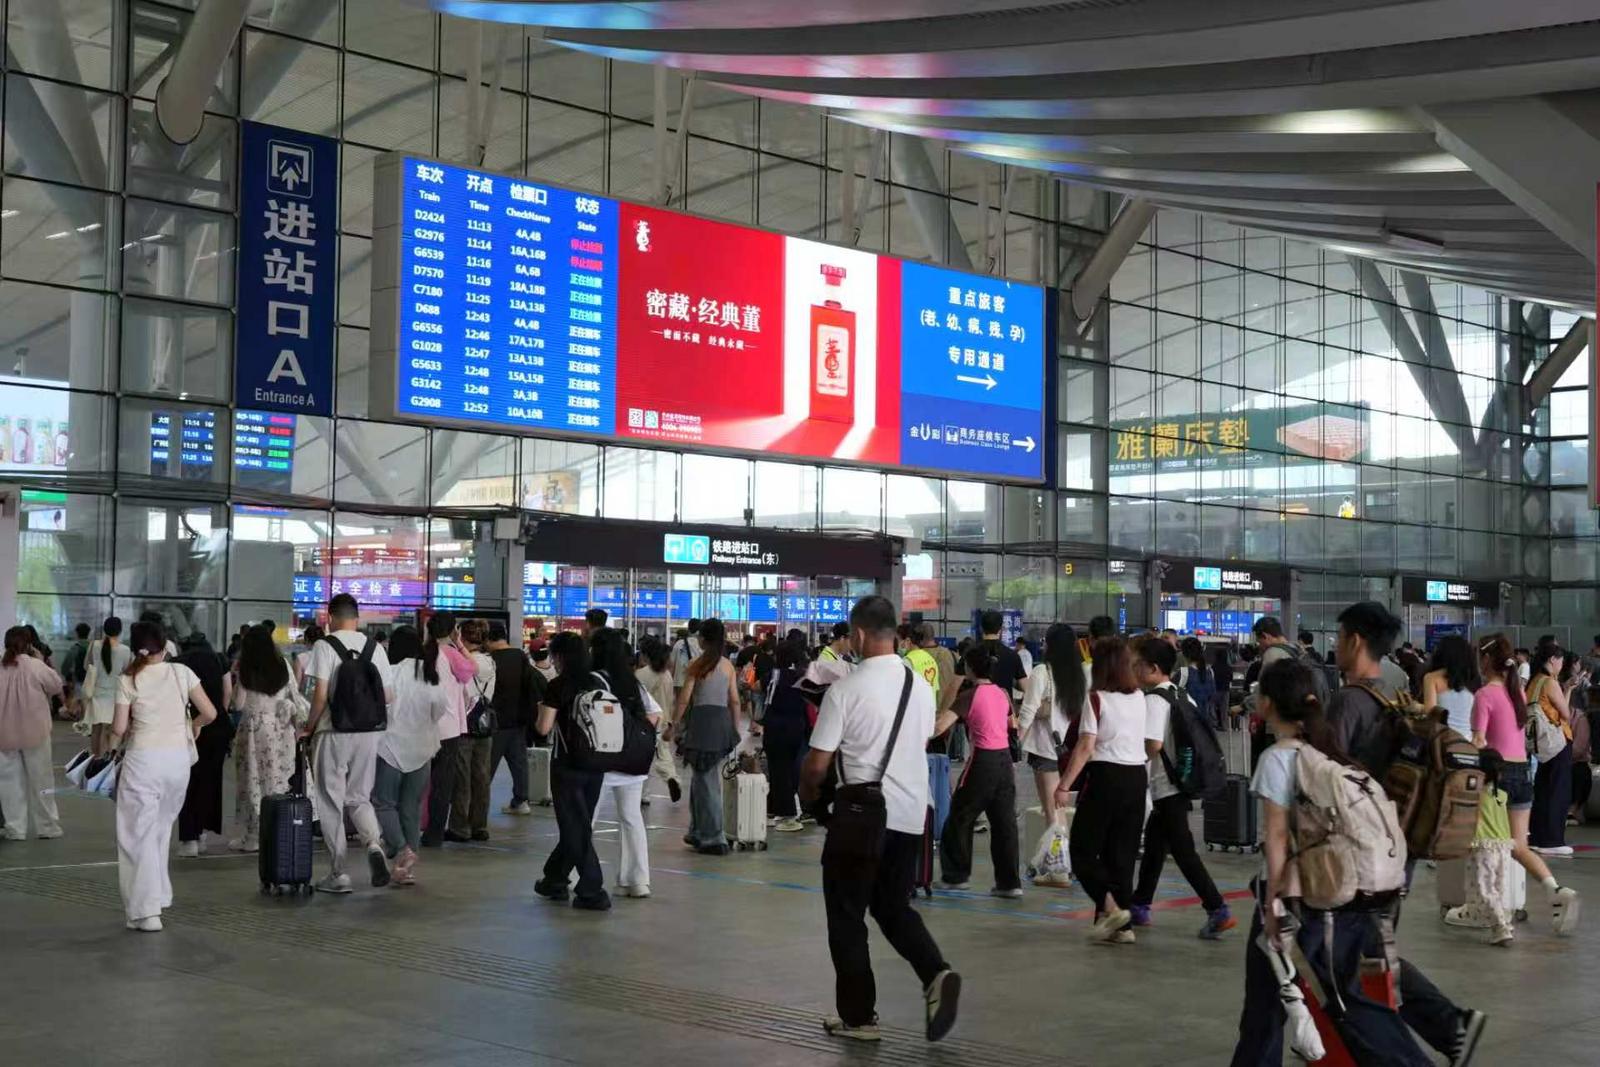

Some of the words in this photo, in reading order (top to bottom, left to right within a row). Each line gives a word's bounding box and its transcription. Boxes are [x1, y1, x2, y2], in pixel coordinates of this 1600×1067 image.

[416, 164, 444, 184] 车次
[467, 174, 493, 195] 开点
[575, 197, 600, 215] 状态
[419, 190, 440, 202] Train
[469, 200, 490, 212] Time
[415, 210, 444, 223] D2424
[468, 220, 491, 232] 11:13
[415, 229, 444, 241] G2976
[468, 238, 491, 250] 11:14
[414, 247, 444, 260] G6539
[467, 256, 491, 268] 11:16
[414, 265, 443, 278] D7570
[467, 275, 491, 286] 11:19
[467, 293, 490, 304] 11:25
[949, 286, 1005, 314] 重点旅客
[466, 311, 489, 322] 12:43
[413, 322, 442, 333] G6556
[466, 329, 490, 340] 12:46
[412, 340, 442, 352] G1028
[466, 348, 489, 358] 12:47
[948, 346, 1005, 371] 专用通道
[255, 388, 304, 405] Entrance
[307, 393, 315, 406] A
[464, 402, 488, 413] 12:52
[712, 540, 759, 555] 铁路进站口
[712, 554, 735, 566] Railway
[736, 555, 761, 566] Entrance
